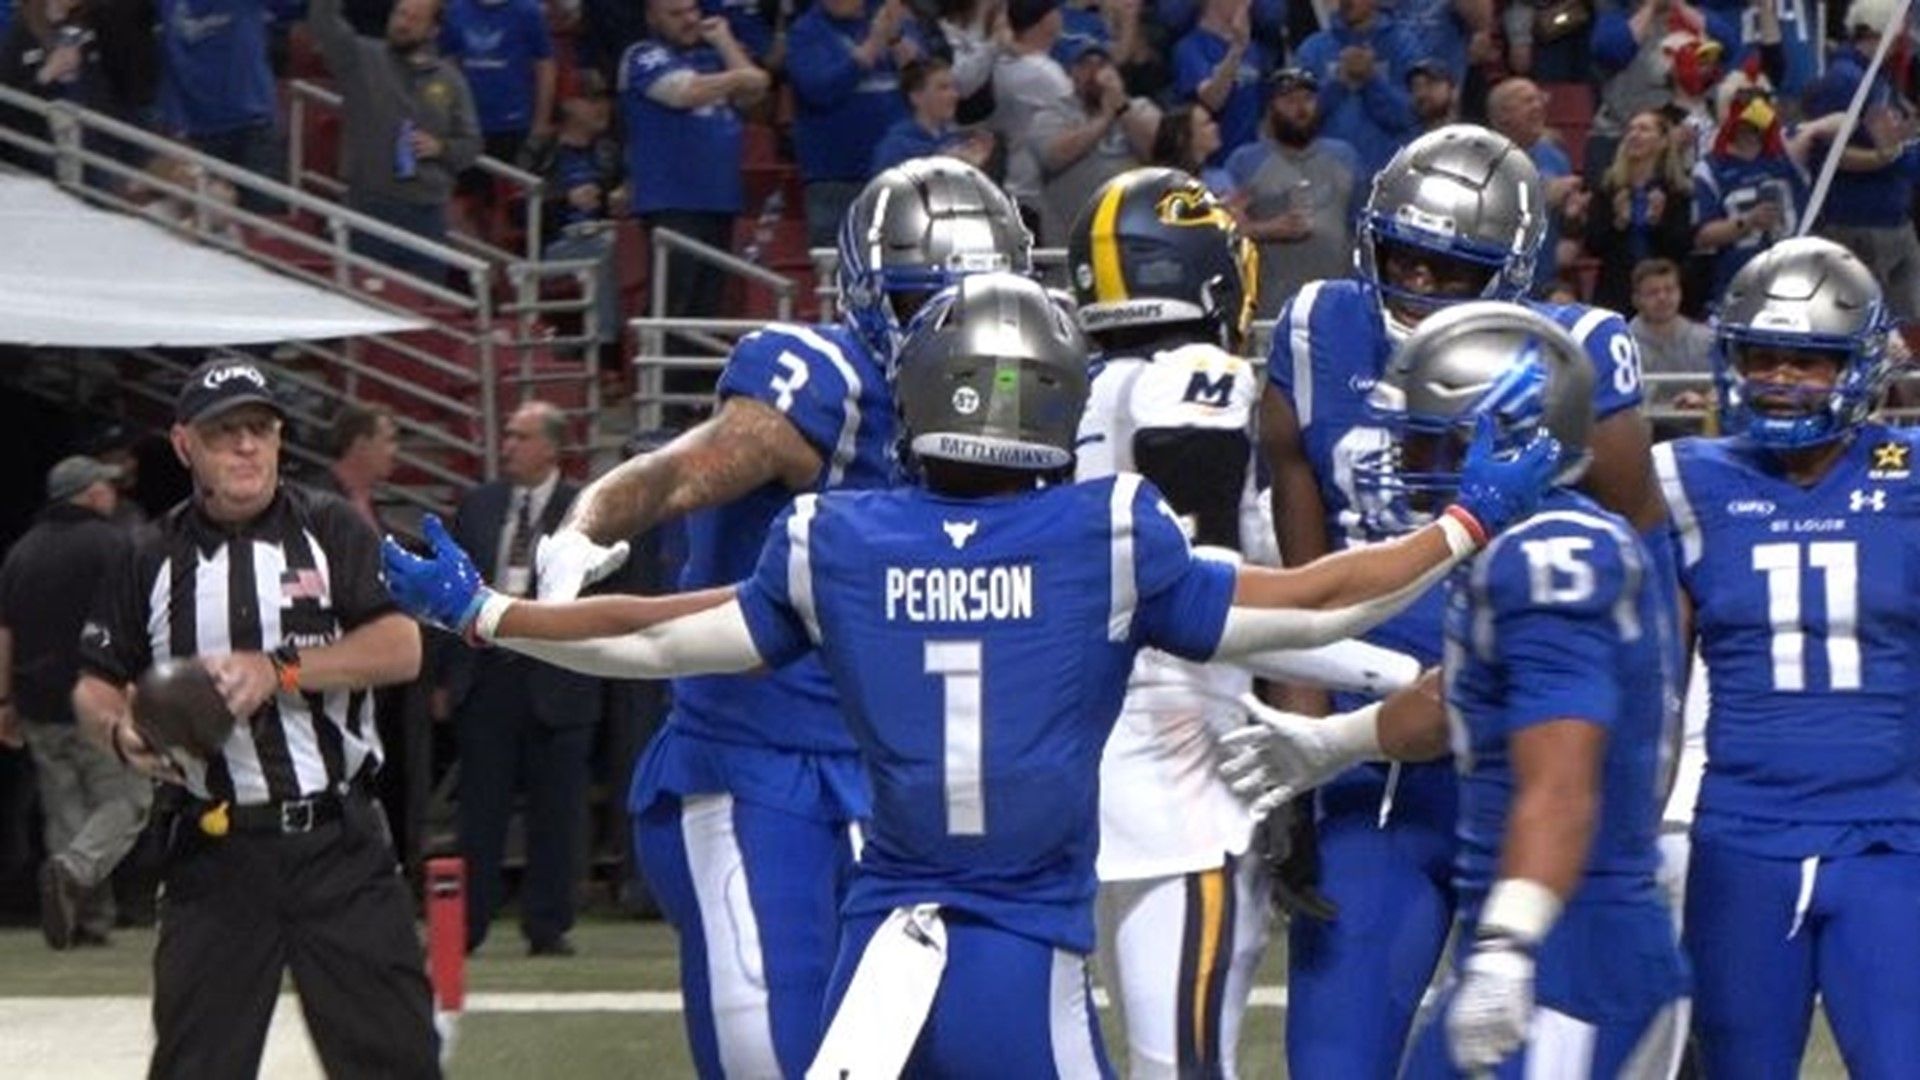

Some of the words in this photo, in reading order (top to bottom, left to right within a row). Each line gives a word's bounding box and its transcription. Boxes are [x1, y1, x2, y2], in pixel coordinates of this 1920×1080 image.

[770, 349, 808, 412] 3
[1182, 371, 1235, 407] M
[886, 566, 1032, 621] PEARSON
[1521, 537, 1595, 602] 15
[1752, 540, 1862, 690] 11
[924, 641, 984, 835] 1
